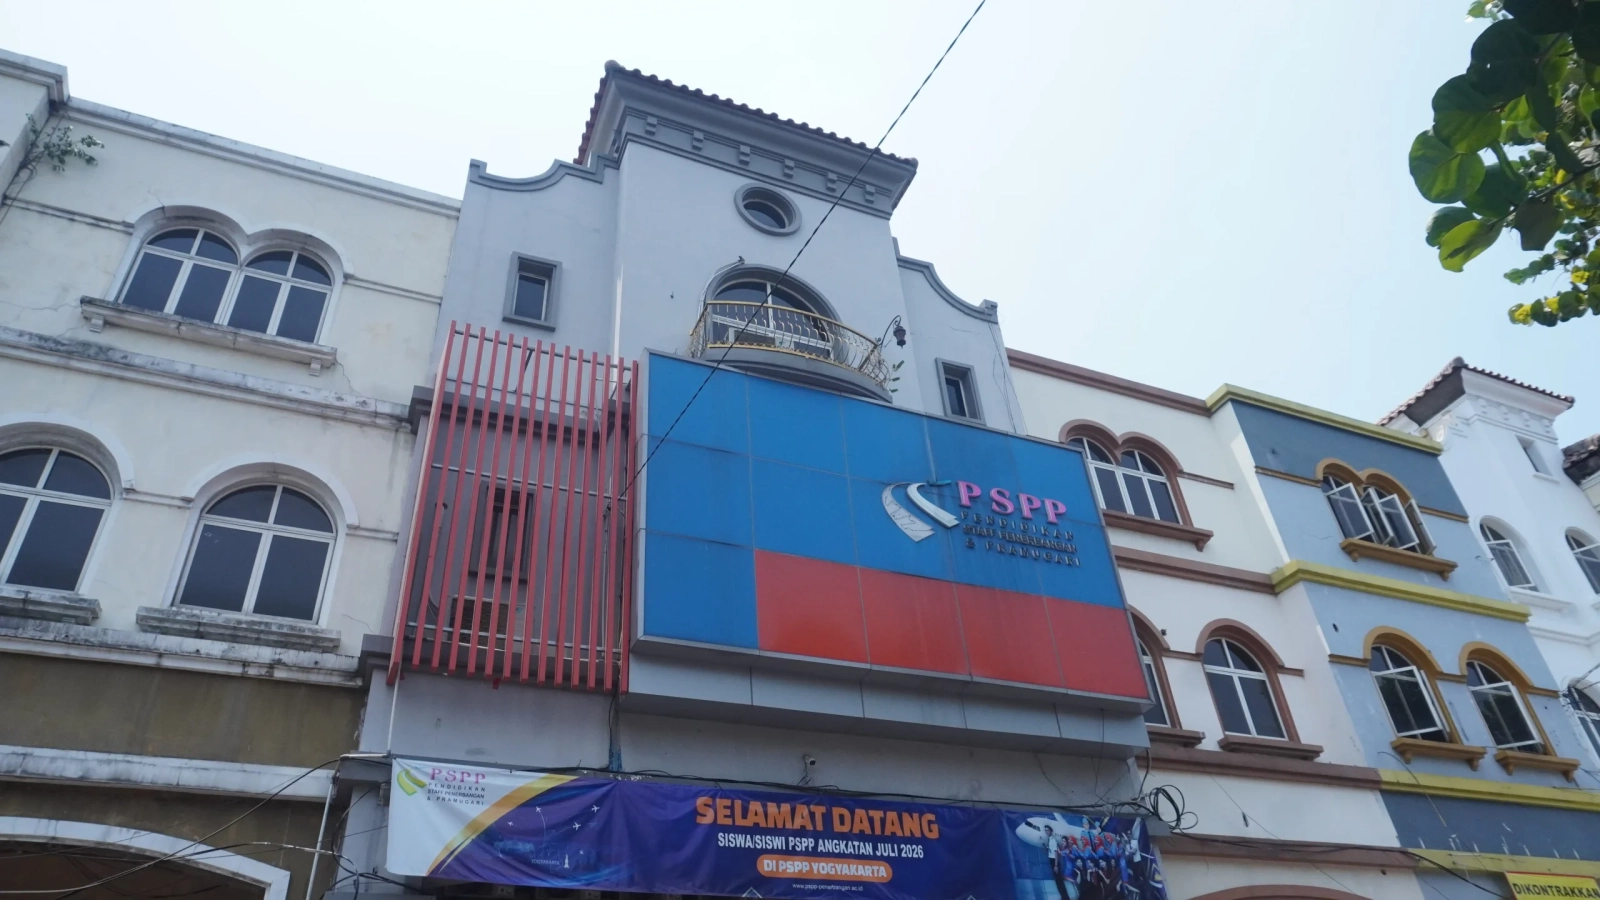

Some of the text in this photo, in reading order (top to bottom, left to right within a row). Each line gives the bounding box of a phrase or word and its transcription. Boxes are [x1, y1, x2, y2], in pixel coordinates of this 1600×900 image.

[957, 481, 1066, 524] PSPP
[961, 511, 1074, 540] PENDIDIKAN
[963, 524, 1077, 553] STAFF PENERBANGAN
[966, 537, 1080, 566] & PRAMUGARI
[428, 782, 486, 792] PENDIDIKAN
[430, 768, 485, 784] PSPP
[436, 796, 484, 806] PRAMUGARI
[444, 790, 485, 799] PENERBANGAN
[696, 797, 939, 839] SELAMAT DATANG
[717, 832, 924, 859] SISWA/SISWI PSPP ANGKATAN JULI 2026
[763, 859, 887, 878] DI PSPP YOGYAKARTA
